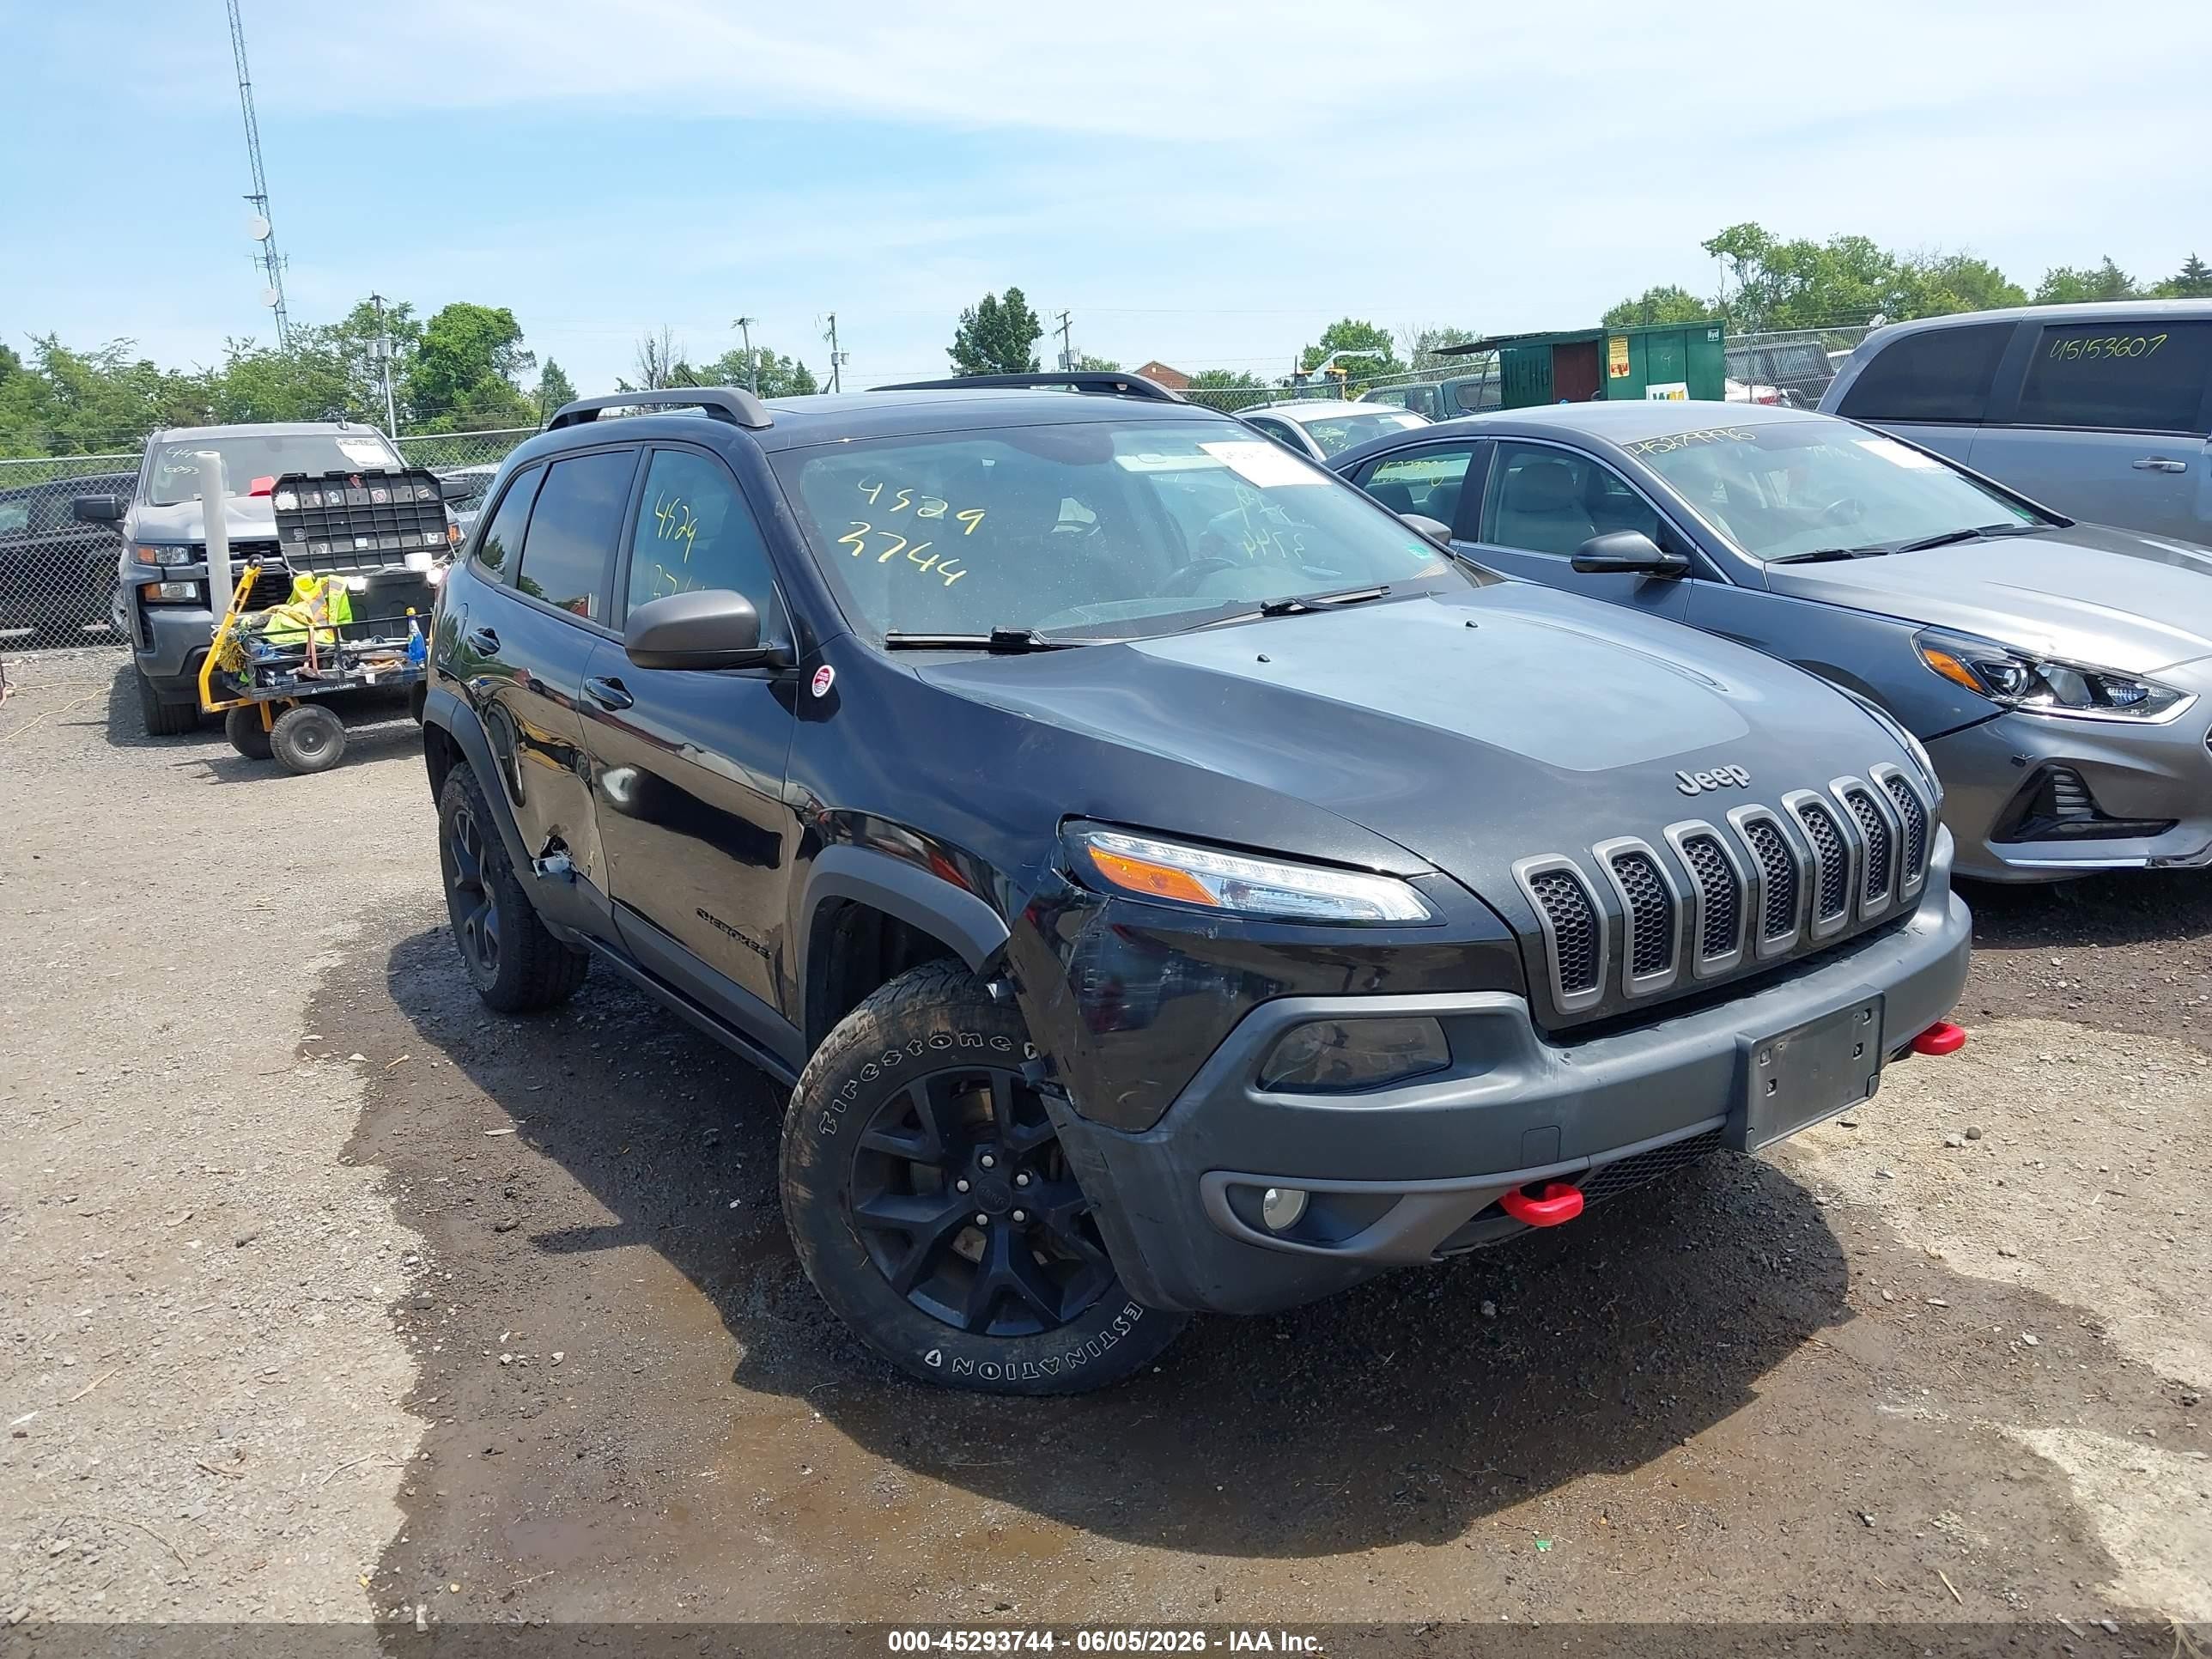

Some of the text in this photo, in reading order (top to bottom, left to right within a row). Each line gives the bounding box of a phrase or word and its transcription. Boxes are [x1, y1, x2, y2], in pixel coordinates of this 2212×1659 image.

[2050, 333, 2167, 361] 45153607
[1626, 428, 1757, 455] 45279996
[655, 489, 699, 563] 4529
[858, 474, 986, 535] 4529
[653, 564, 707, 599] 37
[837, 521, 968, 586] 3744
[1674, 764, 1751, 797] Jeep
[818, 1033, 1012, 1135] Firestone
[952, 1301, 1144, 1380] ESTINATION
